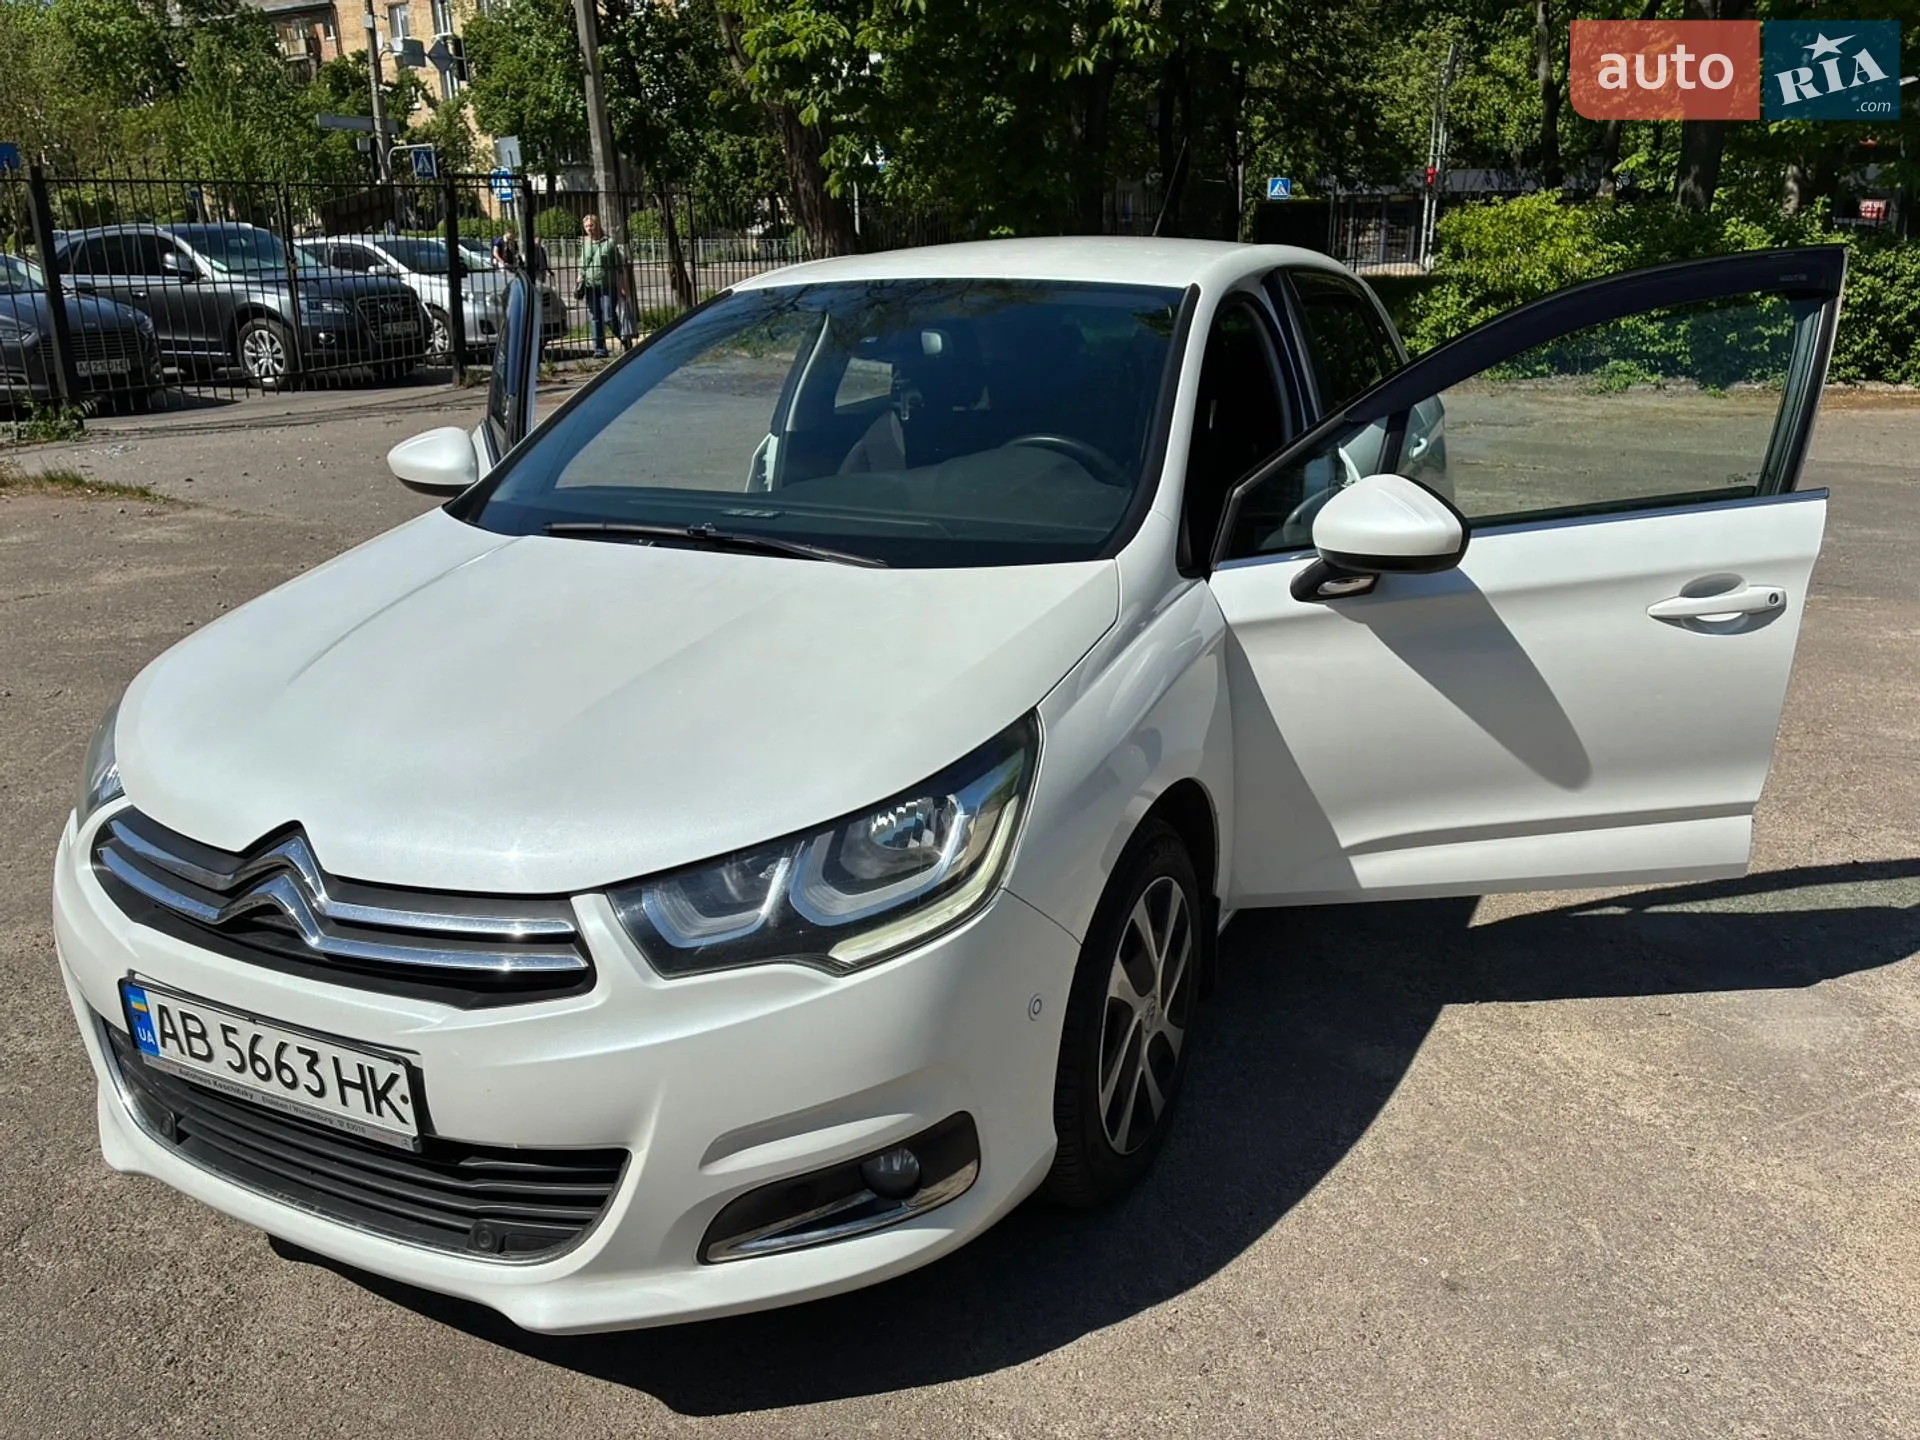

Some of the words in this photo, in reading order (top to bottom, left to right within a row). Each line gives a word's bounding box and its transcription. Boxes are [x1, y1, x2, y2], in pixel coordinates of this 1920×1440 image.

[137, 1026, 156, 1046] UA
[157, 1004, 214, 1062] AB
[220, 1023, 326, 1099] 5663
[332, 1055, 410, 1125] HK
